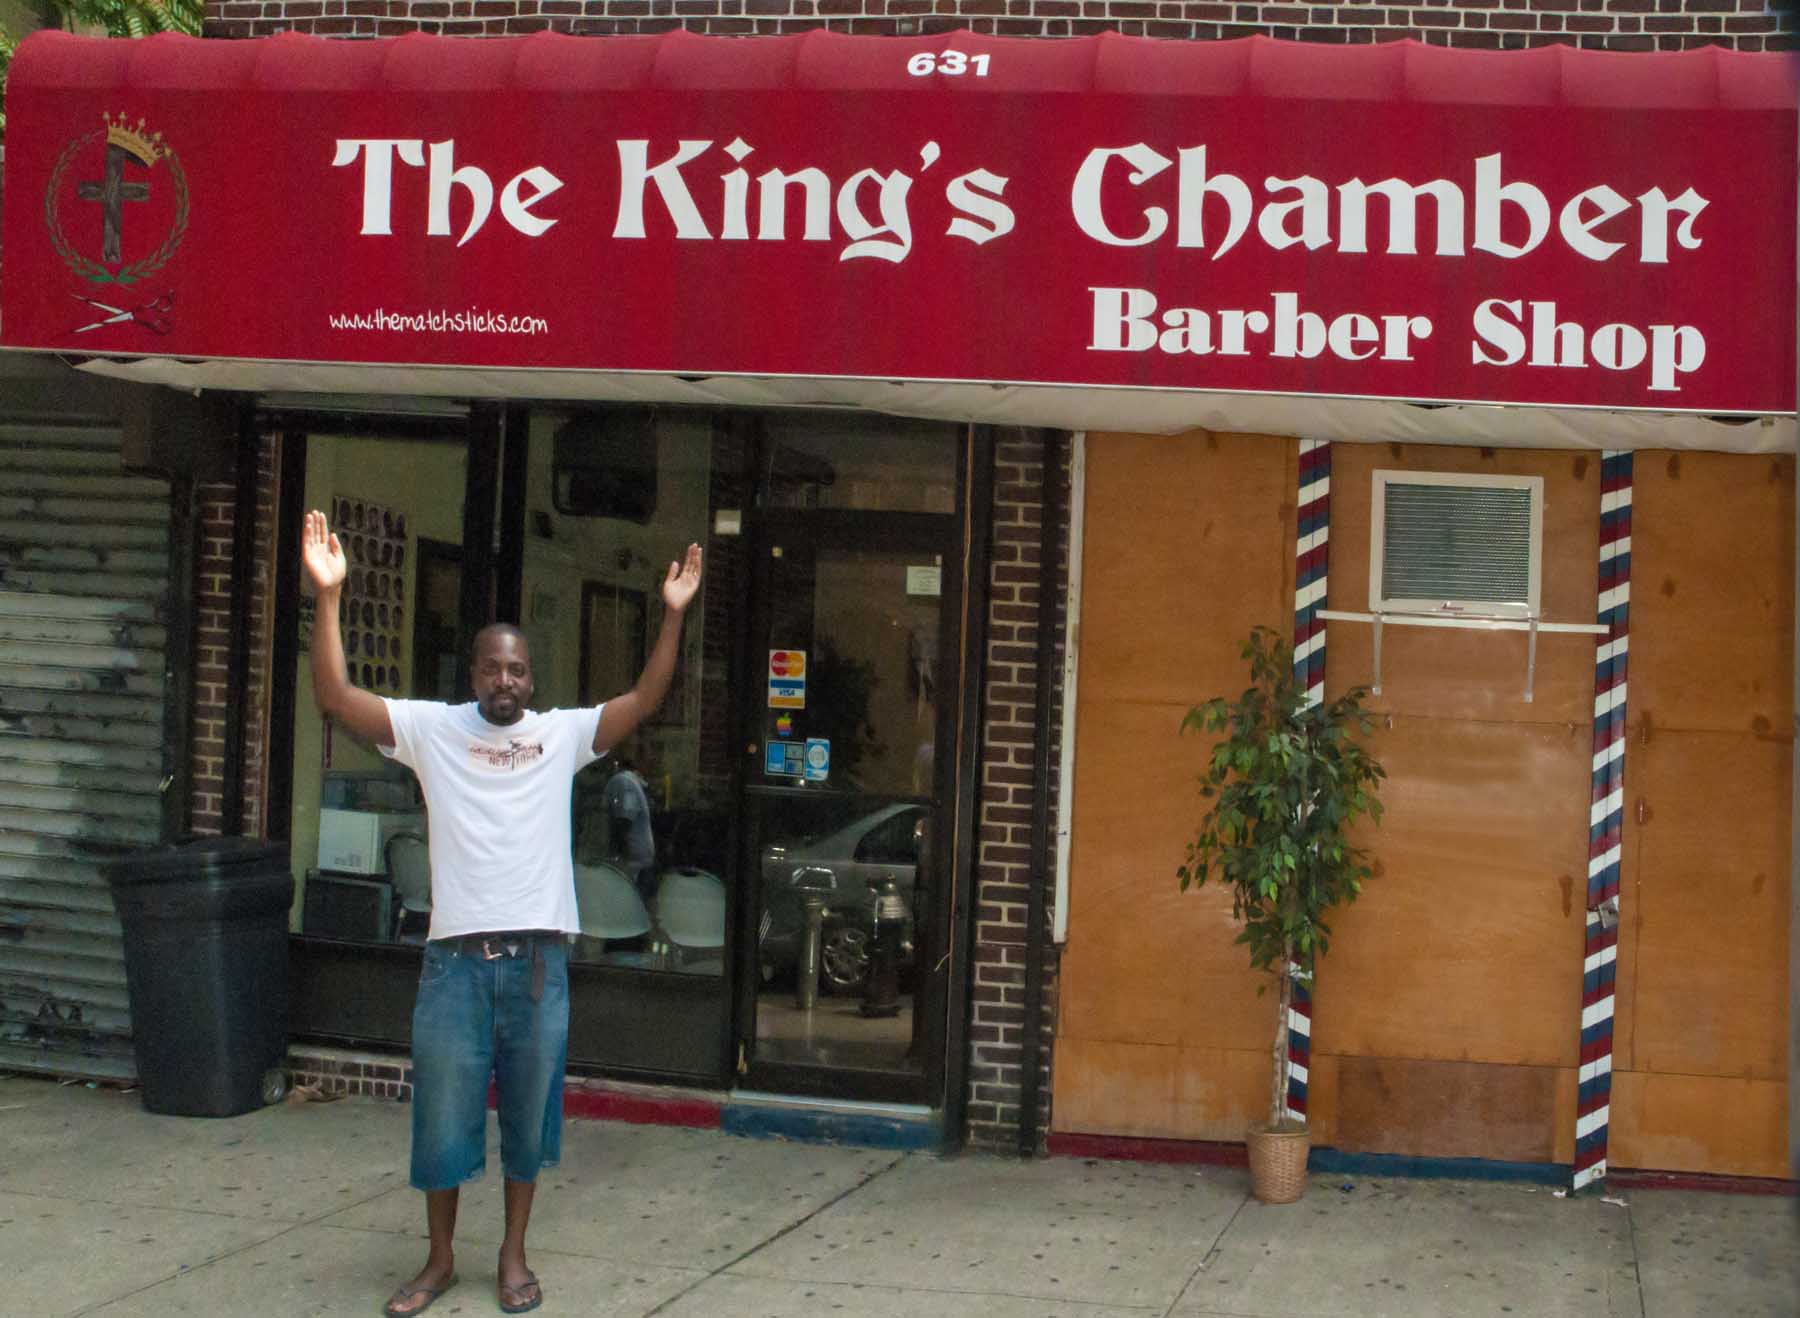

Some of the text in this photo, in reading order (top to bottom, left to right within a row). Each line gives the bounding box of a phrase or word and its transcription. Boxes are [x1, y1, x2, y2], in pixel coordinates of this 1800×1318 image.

[907, 49, 991, 77] 631
[331, 137, 1710, 264] The King's Chamber
[329, 305, 549, 334] www.thematchsticks.com
[1086, 287, 1707, 392] Barber Shop
